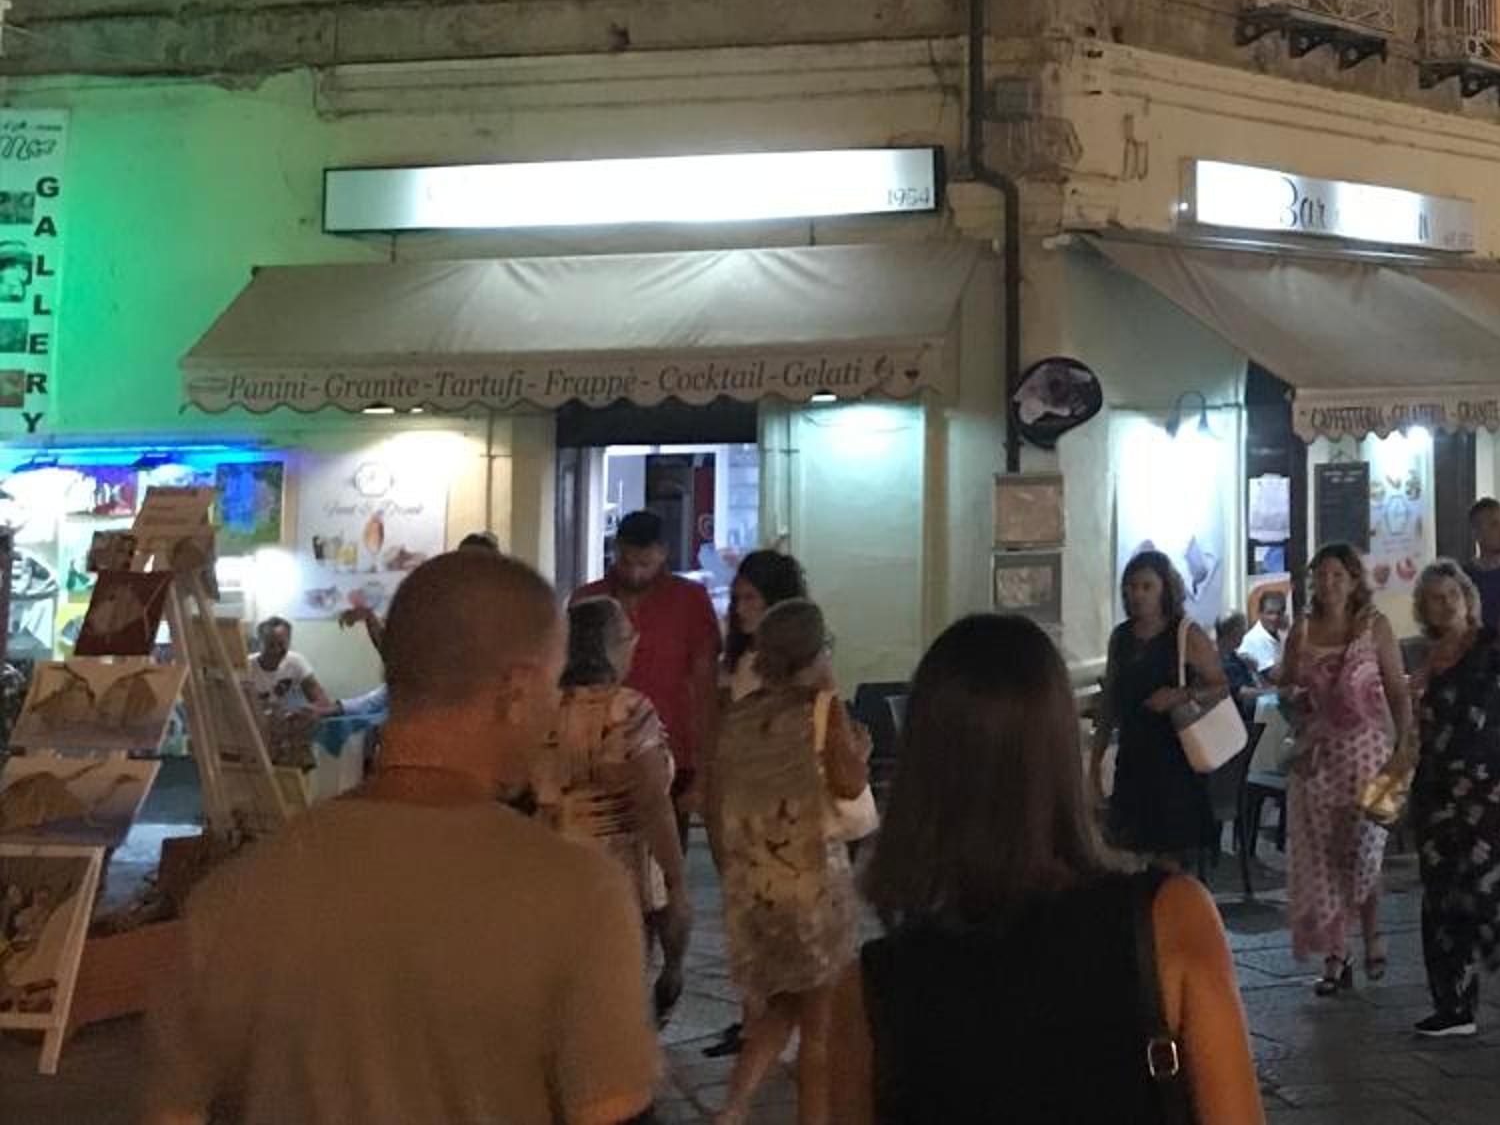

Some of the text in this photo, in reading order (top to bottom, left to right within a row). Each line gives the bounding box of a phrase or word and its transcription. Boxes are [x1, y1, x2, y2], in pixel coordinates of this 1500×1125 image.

[21, 176, 60, 434] GALLERY
[226, 374, 306, 400] Panini
[323, 371, 419, 399] Granite
[436, 369, 526, 399] Tartufi
[657, 361, 766, 391] Cocktail
[783, 357, 864, 388] Gelati
